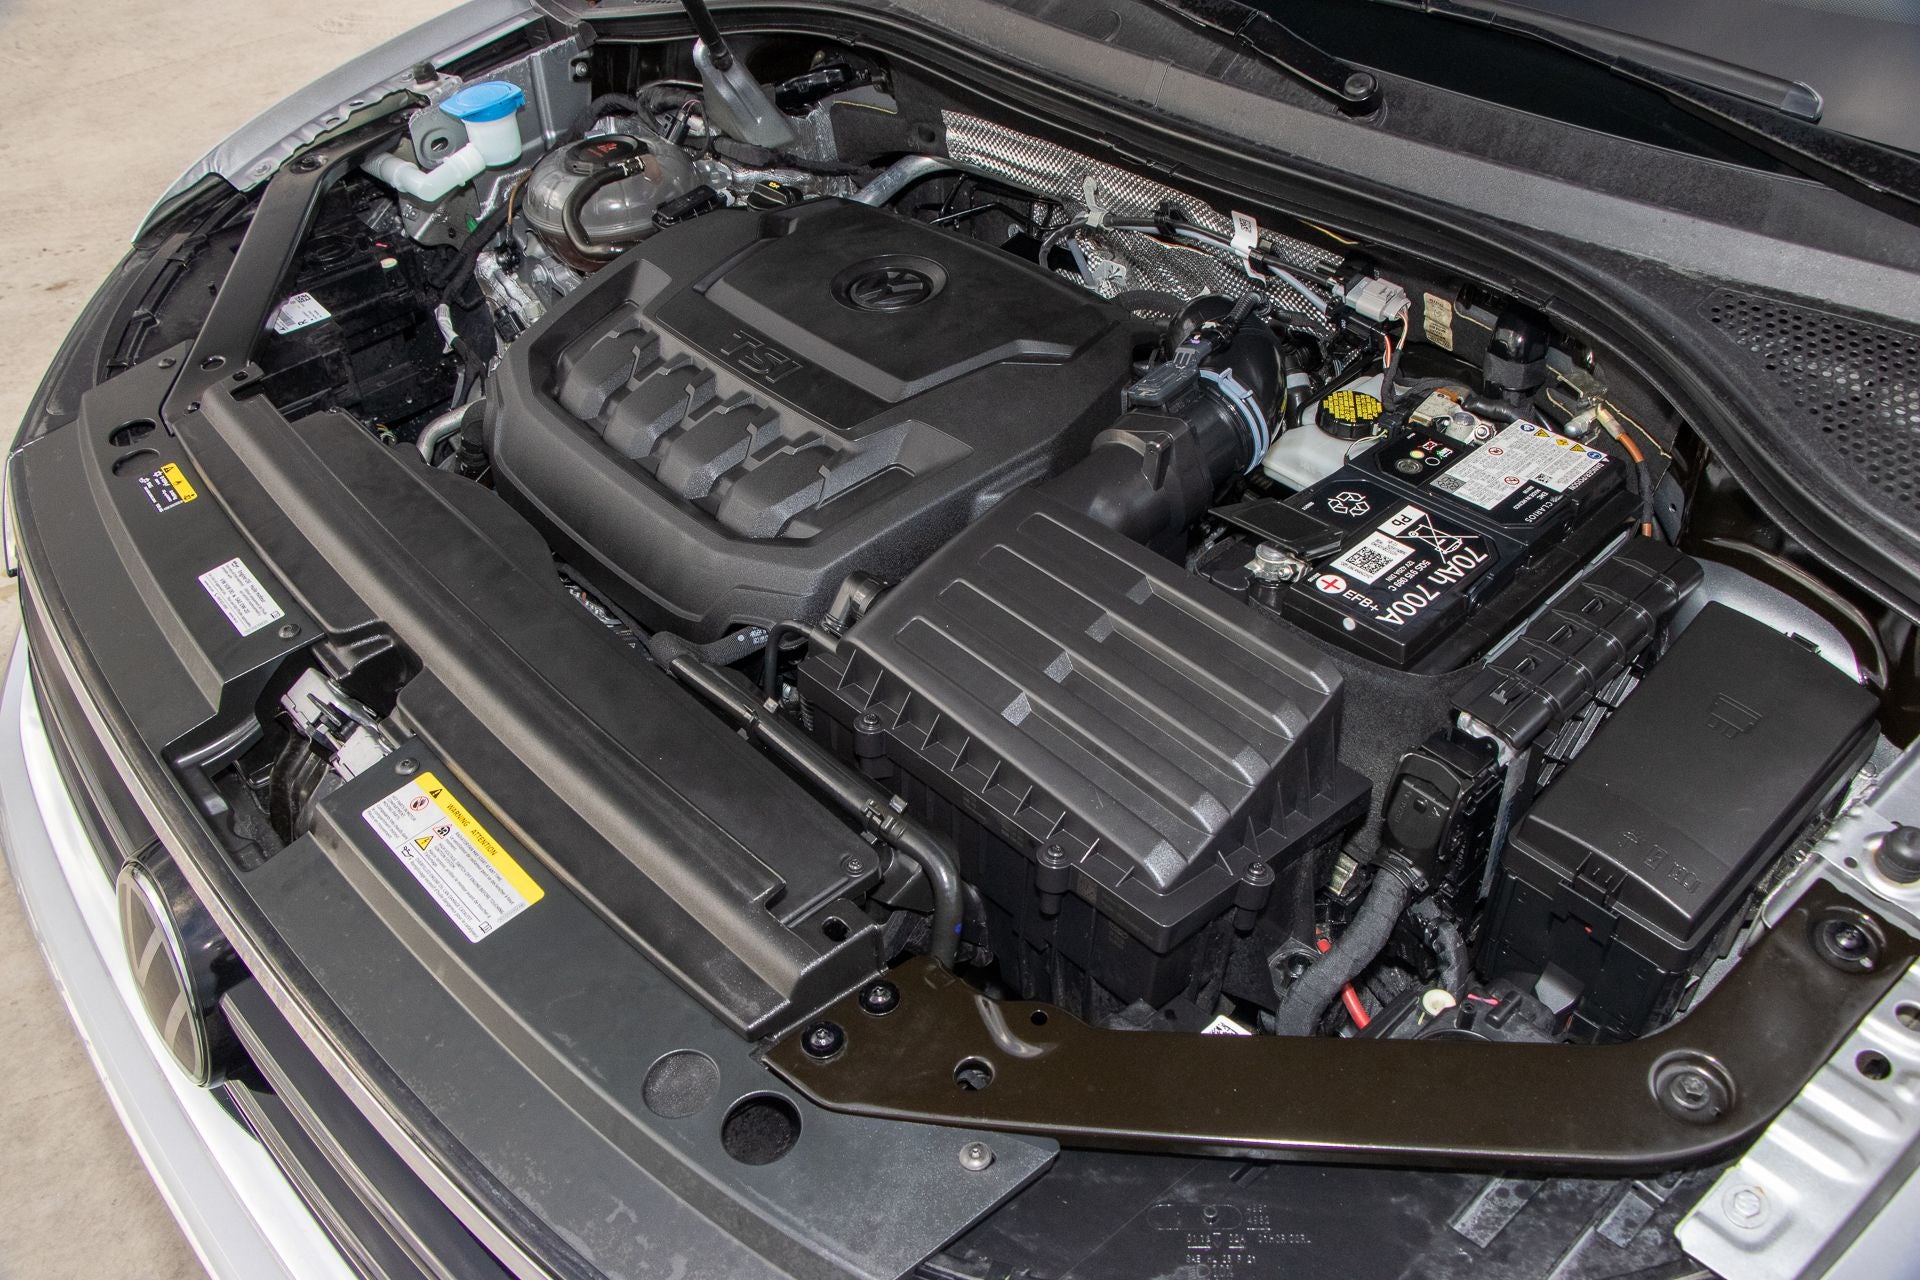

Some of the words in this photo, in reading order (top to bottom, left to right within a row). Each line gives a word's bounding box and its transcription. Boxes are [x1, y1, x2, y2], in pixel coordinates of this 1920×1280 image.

[720, 330, 803, 384] TSI
[1391, 513, 1412, 527] Pb
[1523, 501, 1554, 522] CLARIOS
[1428, 546, 1490, 589] 70Ah
[1343, 590, 1380, 613] EFB+
[1376, 580, 1441, 626] 700A
[446, 803, 470, 826] WARNING
[470, 828, 497, 855] ATTENTION
